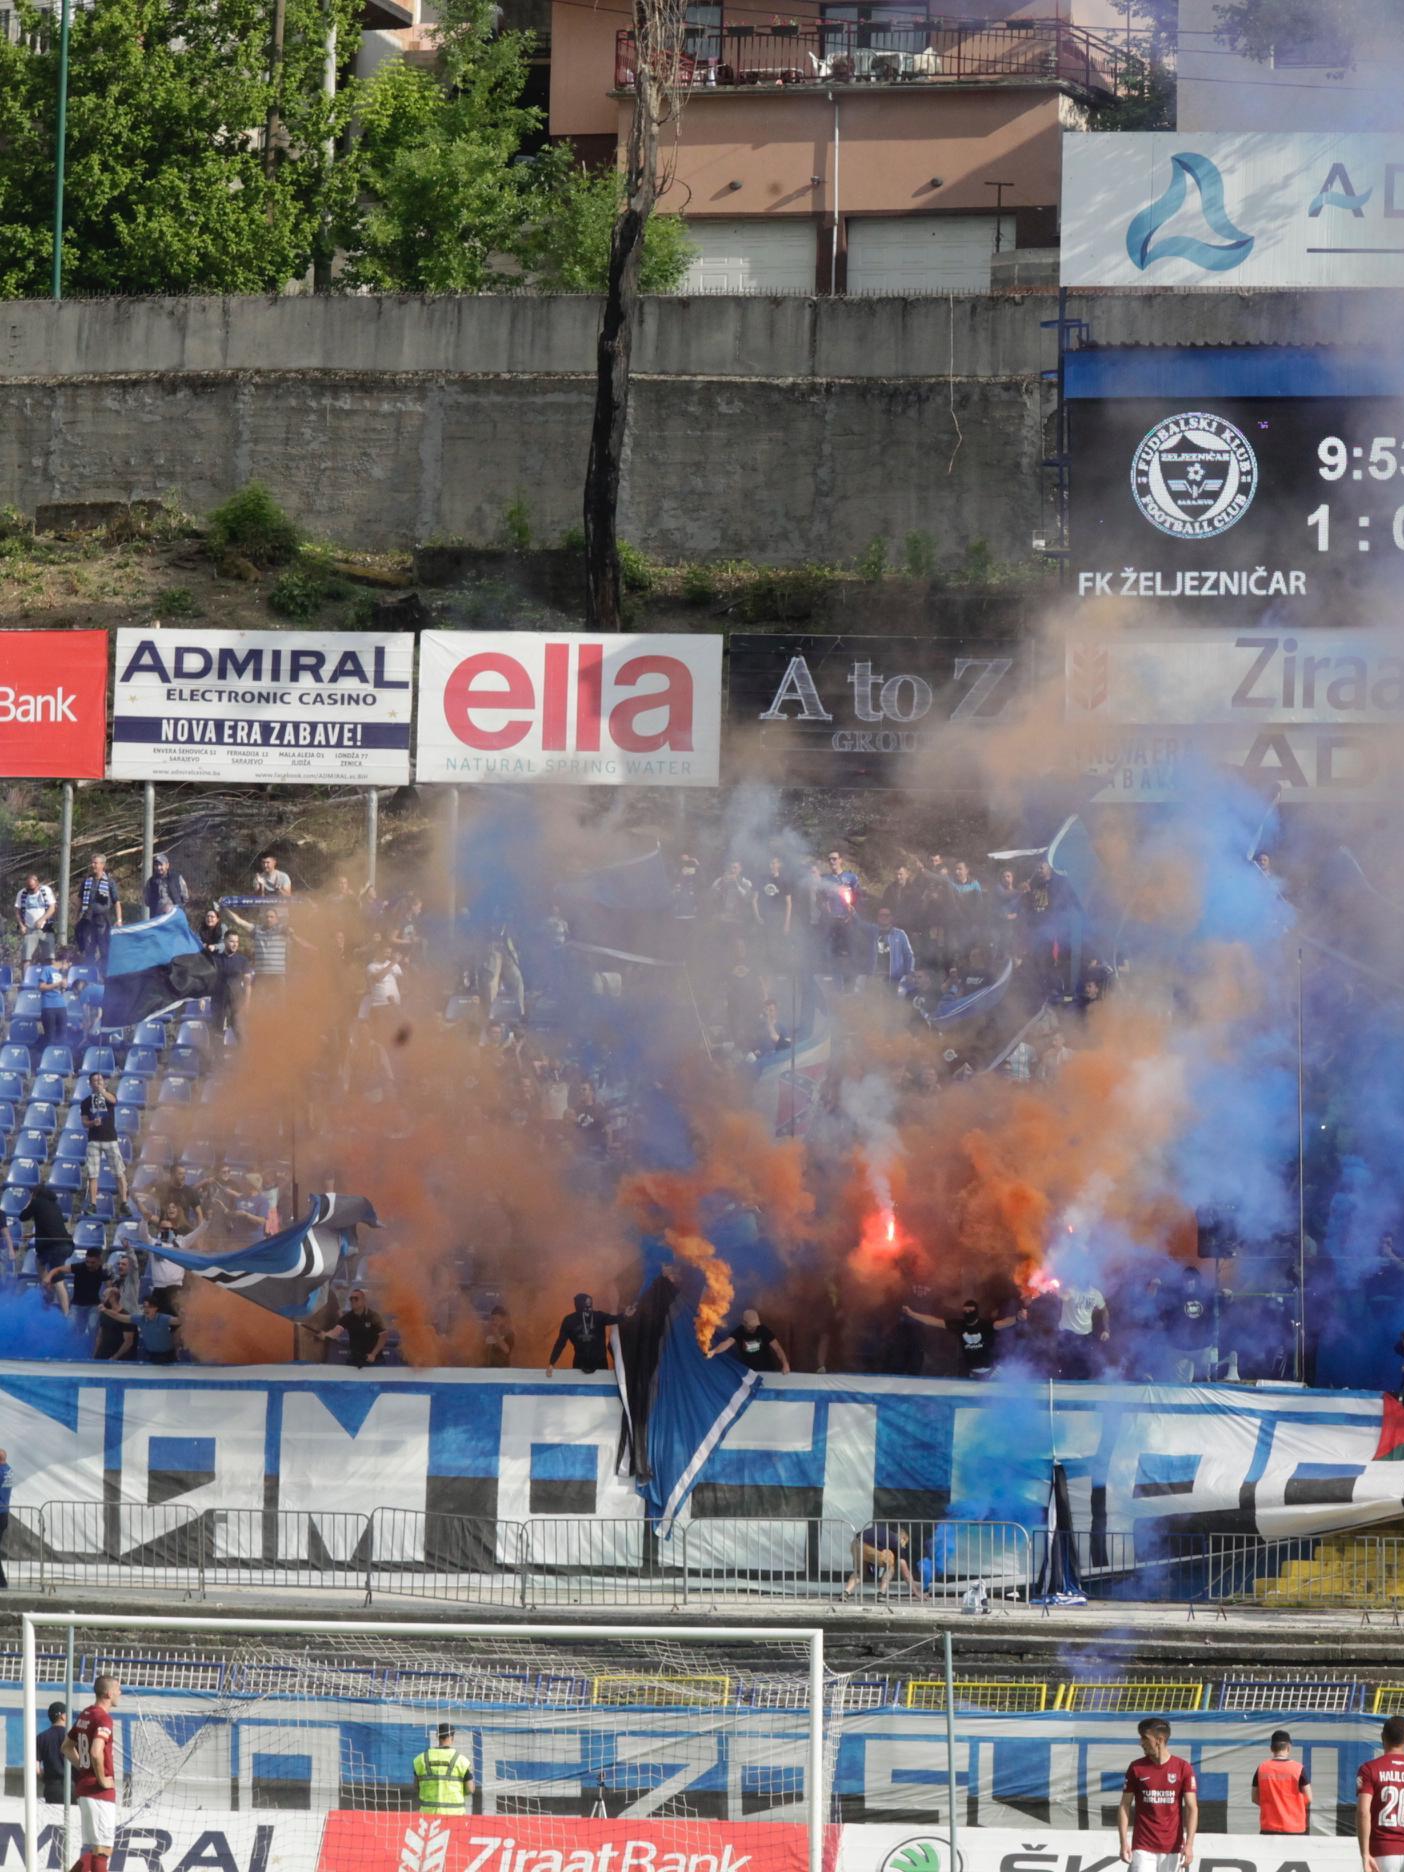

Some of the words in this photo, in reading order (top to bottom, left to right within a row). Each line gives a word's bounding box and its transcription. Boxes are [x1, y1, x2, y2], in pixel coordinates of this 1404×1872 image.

[1137, 416, 1218, 472] FUDBALSKI
[1220, 428, 1251, 472] KLUB
[1140, 494, 1213, 535] FOOTBALL
[1212, 493, 1248, 529] CLUB
[1306, 504, 1330, 552] 1
[1078, 571, 1114, 596] FK
[1120, 566, 1307, 596] ŽELJEZNIČAR
[119, 640, 410, 690] ADMIRAL
[166, 688, 292, 706] ELECTRONIC
[298, 691, 378, 707] CASINO
[443, 642, 695, 754] ella
[759, 655, 833, 721] A
[847, 658, 933, 722] to
[950, 657, 1013, 721] Z
[161, 718, 217, 743] NOVA
[223, 720, 263, 745] ERA
[269, 722, 363, 747] ZABAVE!
[446, 756, 536, 775] NATURAL
[544, 757, 619, 777] SPRING
[625, 758, 693, 777] WATER
[1142, 1789, 1176, 1797] TURKISH
